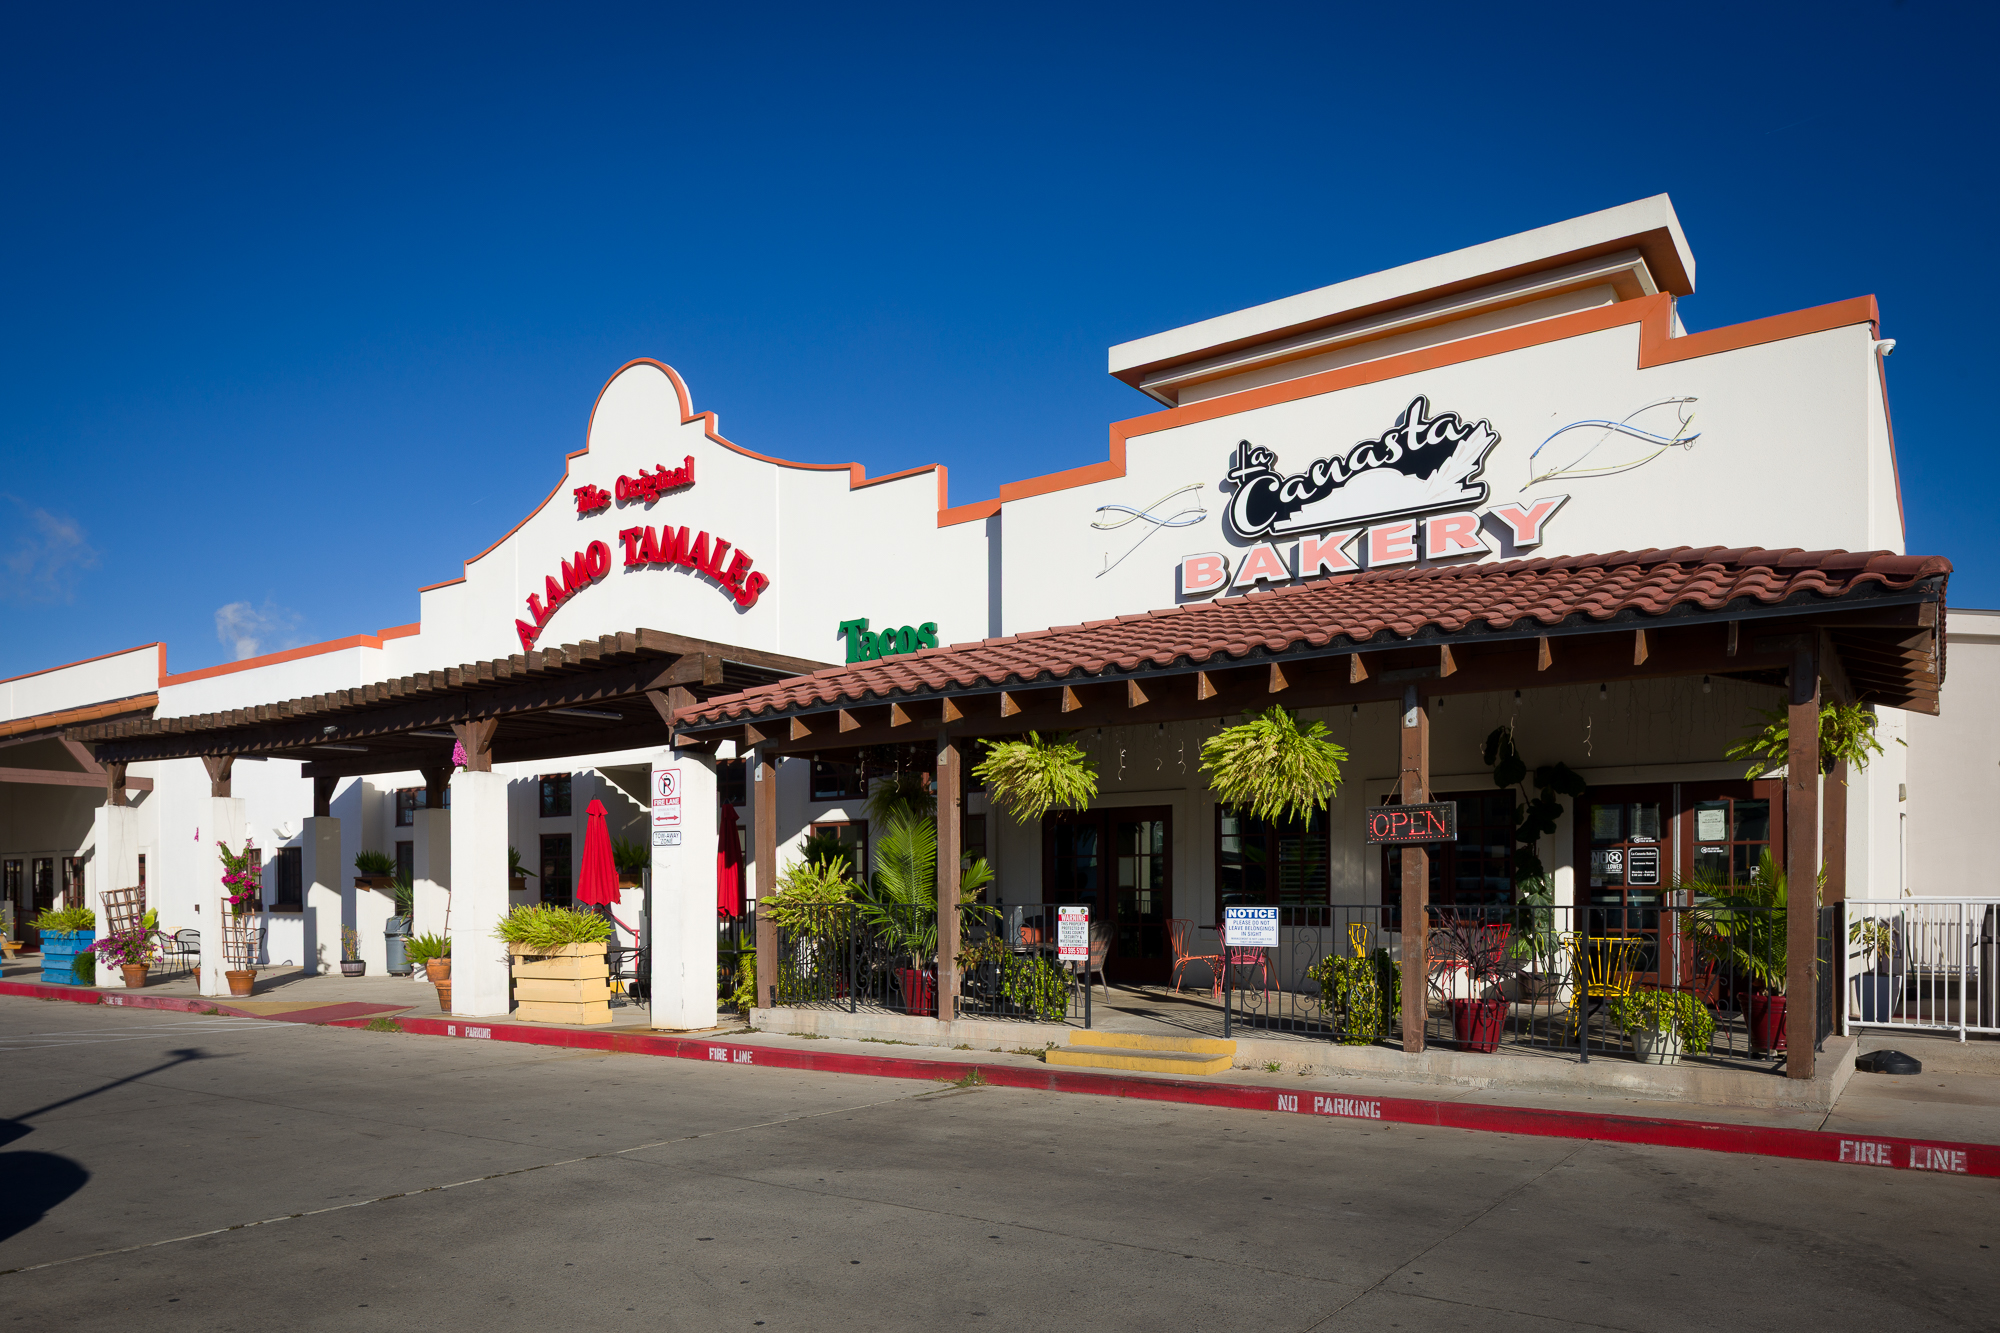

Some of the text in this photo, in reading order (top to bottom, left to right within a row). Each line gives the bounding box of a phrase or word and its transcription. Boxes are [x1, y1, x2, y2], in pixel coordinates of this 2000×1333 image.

[1230, 441, 1274, 482] La
[1233, 396, 1478, 533] Canasta
[574, 455, 695, 513] The Original
[1181, 494, 1571, 596] BAKERY
[515, 525, 770, 652] ALAMO TAMALES
[838, 617, 939, 664] Tacos
[1373, 810, 1446, 836] OPEN
[1591, 852, 1608, 863] NO
[1228, 909, 1275, 918] NOTICE
[448, 1025, 491, 1039] NO PARKING
[709, 1047, 753, 1063] FIRE LINE
[1278, 1094, 1380, 1118] NO PARKING
[1839, 1140, 1966, 1171] FIRE LINE
